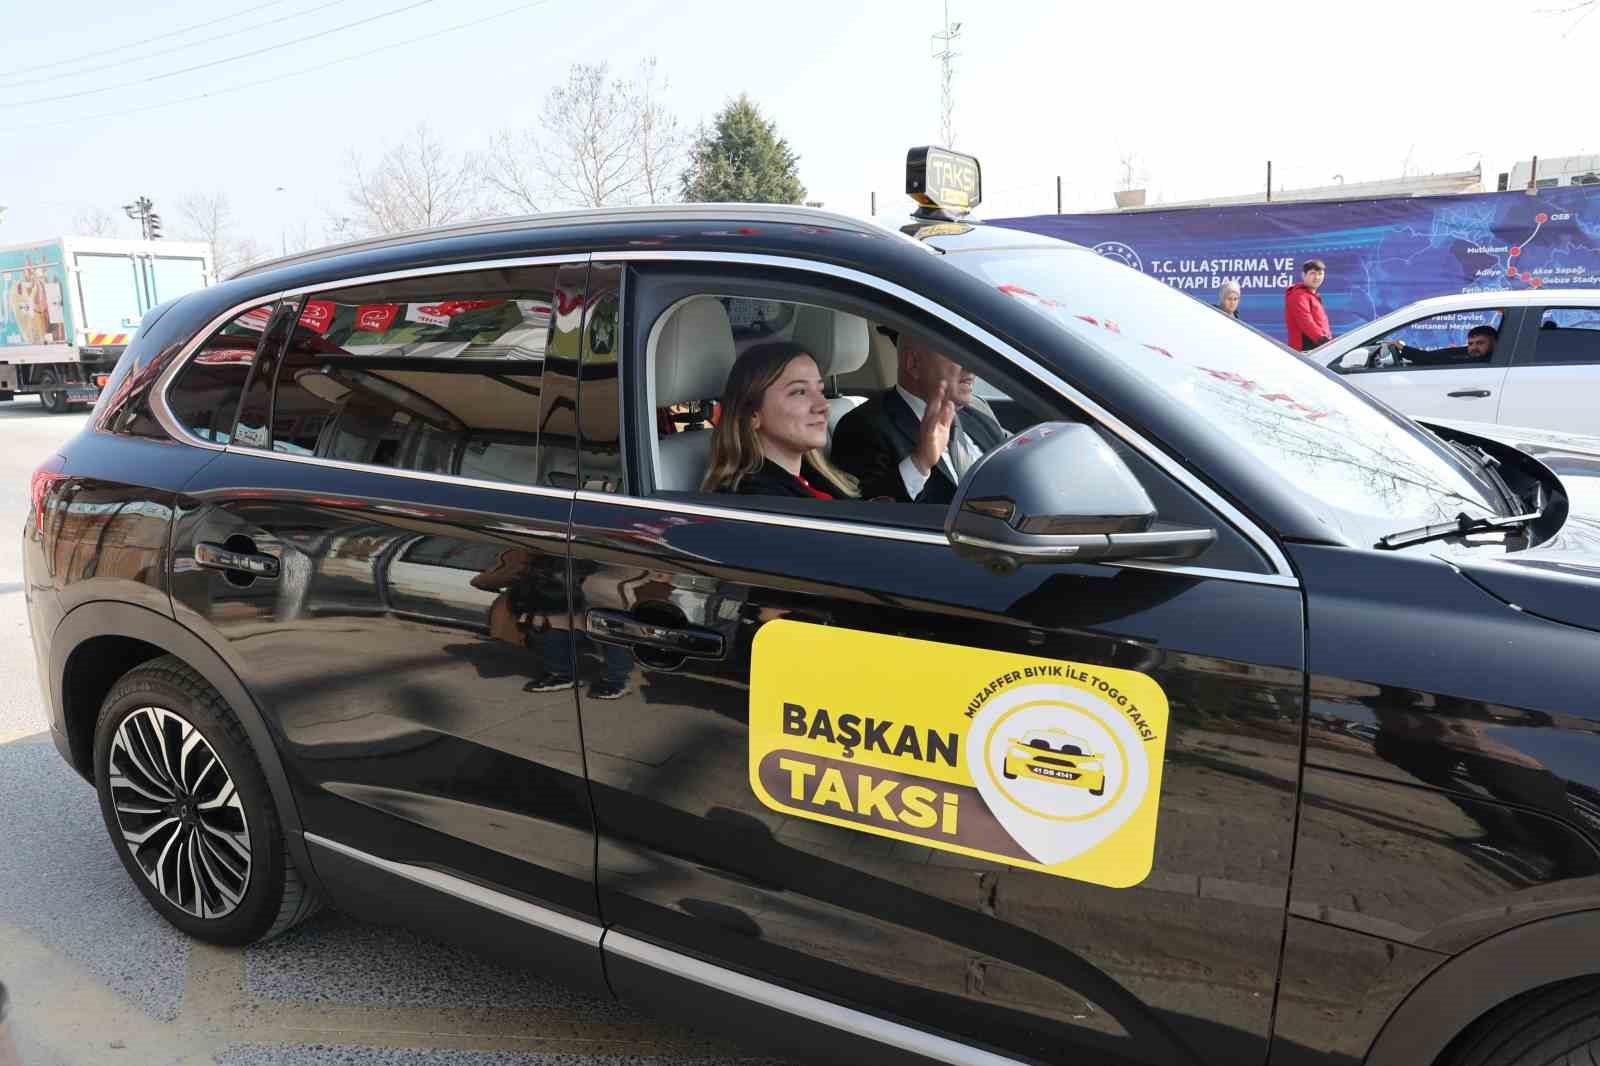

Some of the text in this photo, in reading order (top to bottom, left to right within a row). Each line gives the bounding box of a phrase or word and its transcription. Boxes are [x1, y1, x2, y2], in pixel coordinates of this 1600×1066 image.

[1151, 257, 1295, 275] T.C. ULAŞTIRMA VE
[782, 702, 960, 768] BAŞKAN
[964, 664, 1158, 742] MUZAFFER BIYIK İLE TOGG TAKSİ
